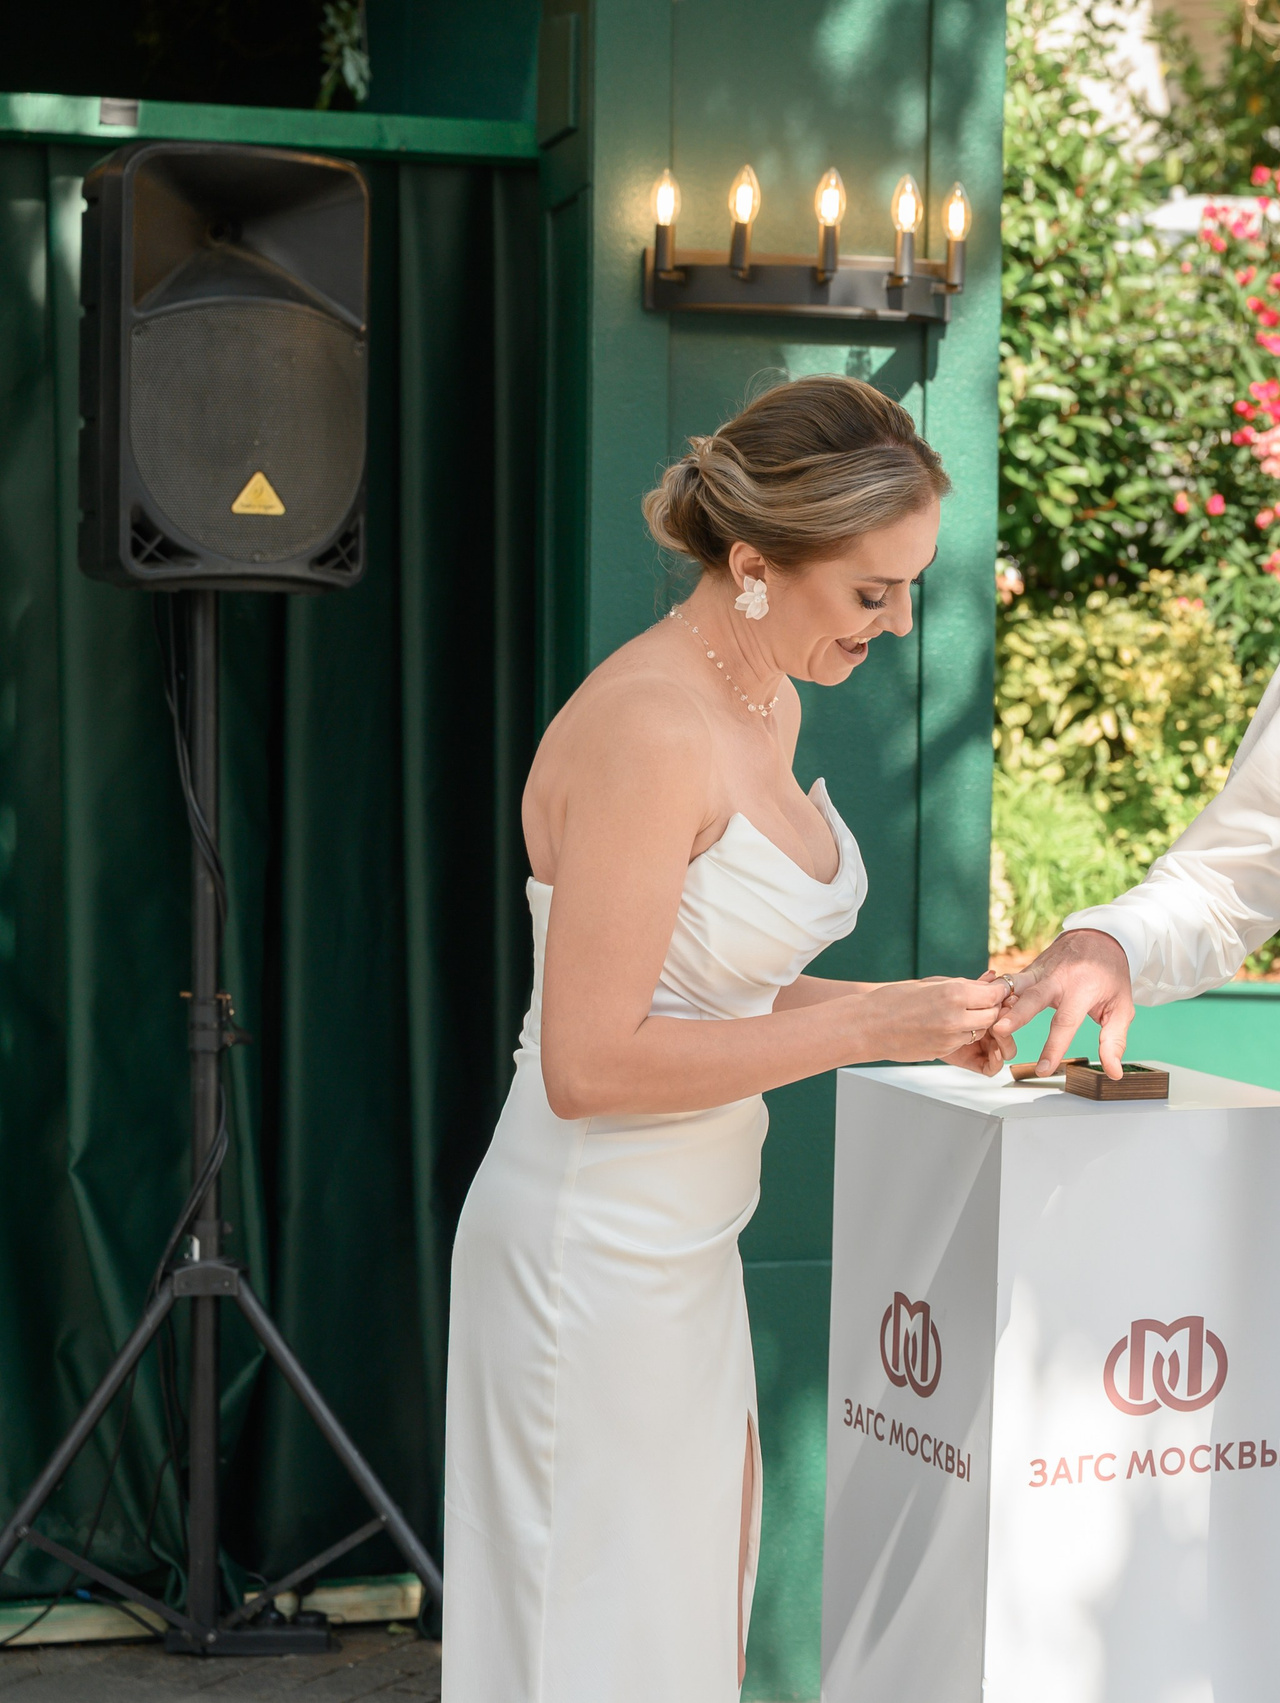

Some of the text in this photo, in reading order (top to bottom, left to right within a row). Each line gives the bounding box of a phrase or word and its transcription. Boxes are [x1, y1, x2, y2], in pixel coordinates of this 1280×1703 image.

[843, 1398, 971, 1482] ЗАГС МОСКВЫ
[1028, 1452, 1117, 1488] ЗАГС
